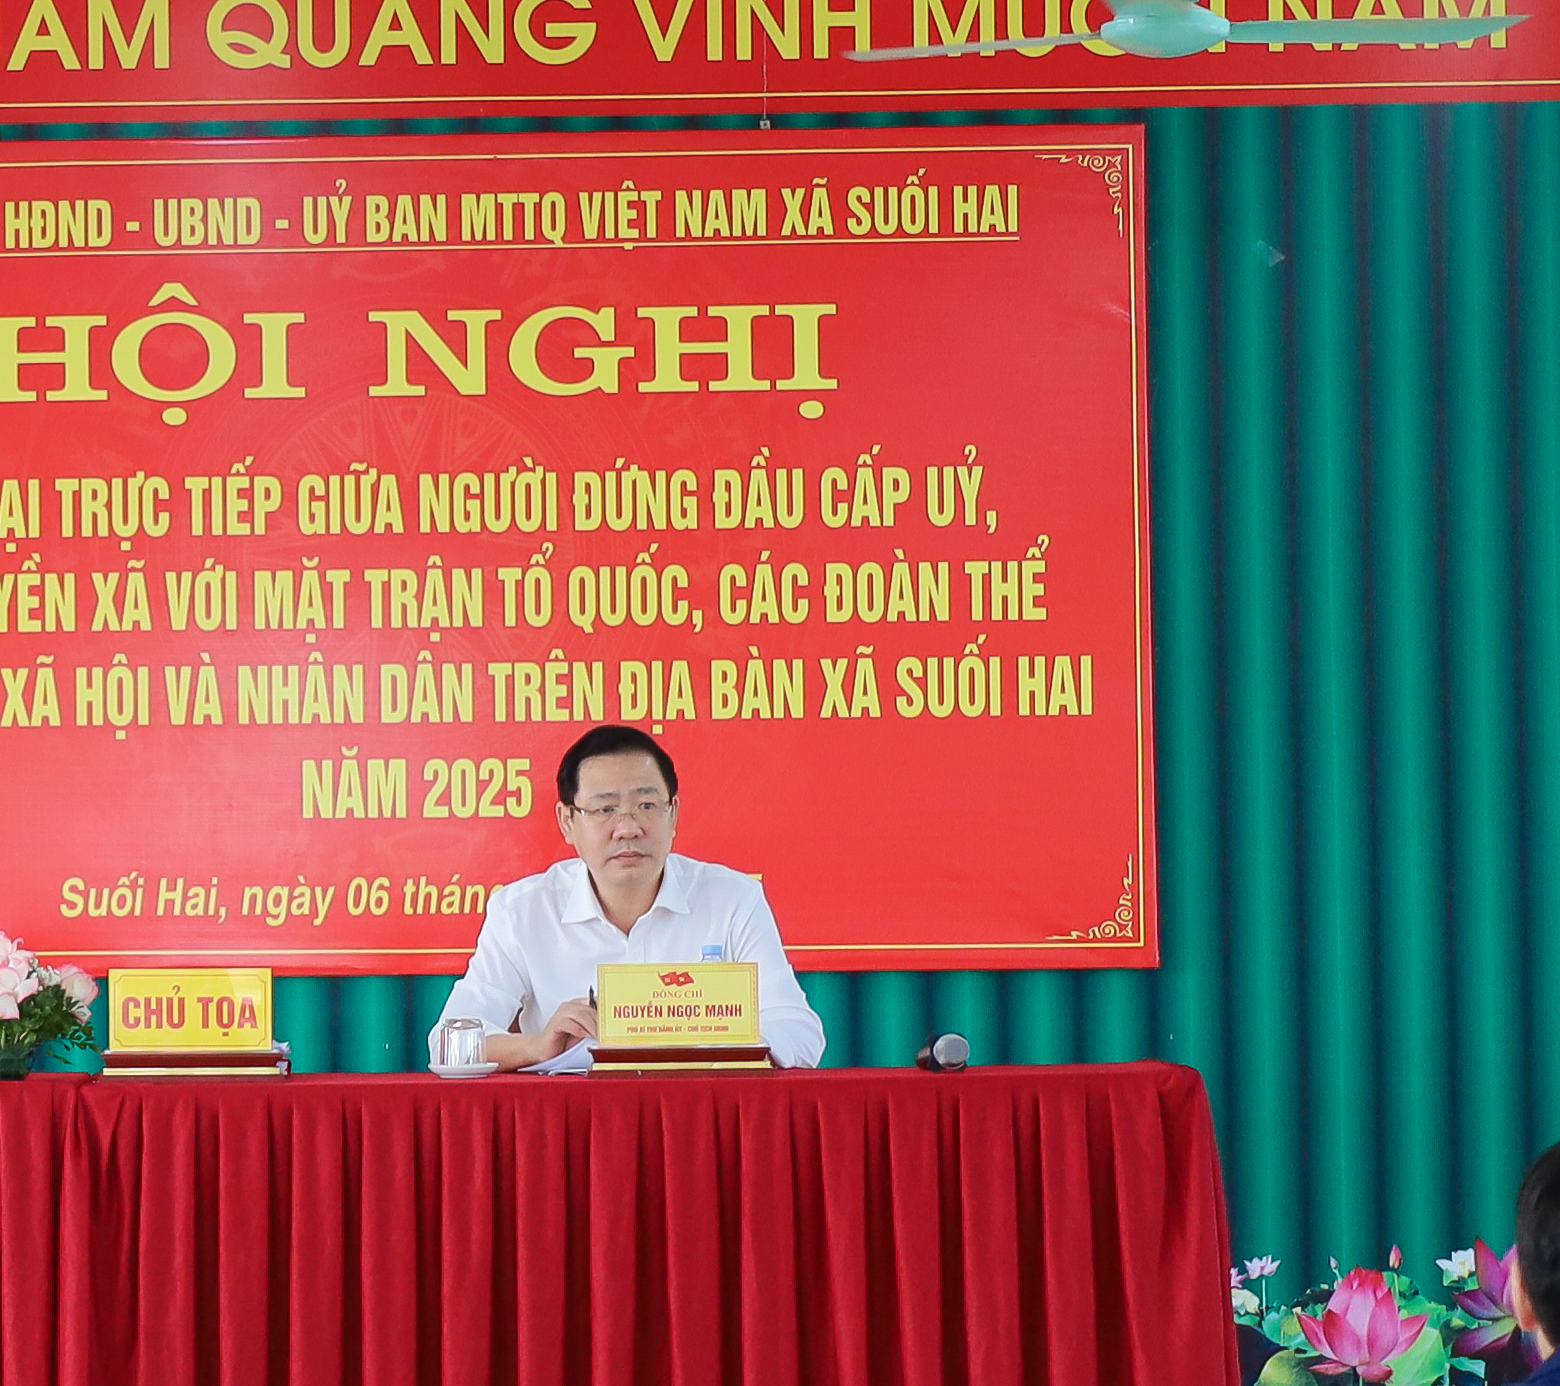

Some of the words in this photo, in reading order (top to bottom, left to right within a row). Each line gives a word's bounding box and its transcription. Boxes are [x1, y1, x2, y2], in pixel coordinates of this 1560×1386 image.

[6, 200, 112, 248] HĐND
[126, 222, 140, 231] -
[154, 198, 261, 246] UBND
[276, 220, 289, 229] -
[304, 179, 353, 244] UỶ
[366, 195, 447, 242] BAN
[462, 193, 566, 245] MTTQ
[579, 180, 662, 250] VIỆT
[676, 189, 767, 237] NAM
[782, 177, 834, 235] XÃ
[848, 168, 939, 235] SUỐI
[954, 185, 1018, 233] HAI
[369, 303, 838, 419] NGHỊ
[55, 471, 169, 550] TRỰC
[185, 456, 281, 535] TIẾP
[298, 463, 404, 535] GIỮA
[420, 457, 557, 533] NGƯỜI
[573, 458, 697, 530] ĐỨNG
[713, 447, 803, 528] ĐẦU
[821, 445, 910, 527] CẤP
[927, 445, 997, 533] UỶ,
[92, 560, 152, 631] XÃ
[166, 558, 237, 630] VỚI
[255, 557, 350, 642] MẶT
[364, 555, 482, 641] TRẬN
[498, 542, 553, 627] TỔ
[569, 544, 702, 633] QUỐC,
[720, 551, 808, 624] CÁC
[824, 549, 949, 622] ĐOÀN
[965, 535, 1049, 620] THỂ
[1, 655, 60, 727] XÃ
[76, 653, 149, 739] HỘI
[165, 653, 223, 725] VÀ
[238, 652, 364, 724] NHÂN
[382, 650, 473, 723] DÂN
[488, 649, 603, 721] TRÊN
[619, 661, 695, 735] ĐỊA
[711, 646, 803, 719] BÀN
[820, 646, 880, 717] XÃ
[897, 634, 1000, 717] SUỐI
[1019, 656, 1093, 715] HAI
[303, 747, 407, 819] NĂM
[424, 758, 533, 818] 2025
[60, 872, 145, 918] Suối
[157, 877, 227, 923] Hai,
[242, 876, 335, 927] ngày
[347, 876, 391, 916] 06
[403, 874, 504, 915] thán
[121, 985, 186, 1029] CHỦ
[196, 996, 258, 1037] TỌA
[613, 1000, 663, 1018] NGUYỄN
[667, 1004, 701, 1021] NGỌC
[705, 1004, 743, 1020] MẠNH
